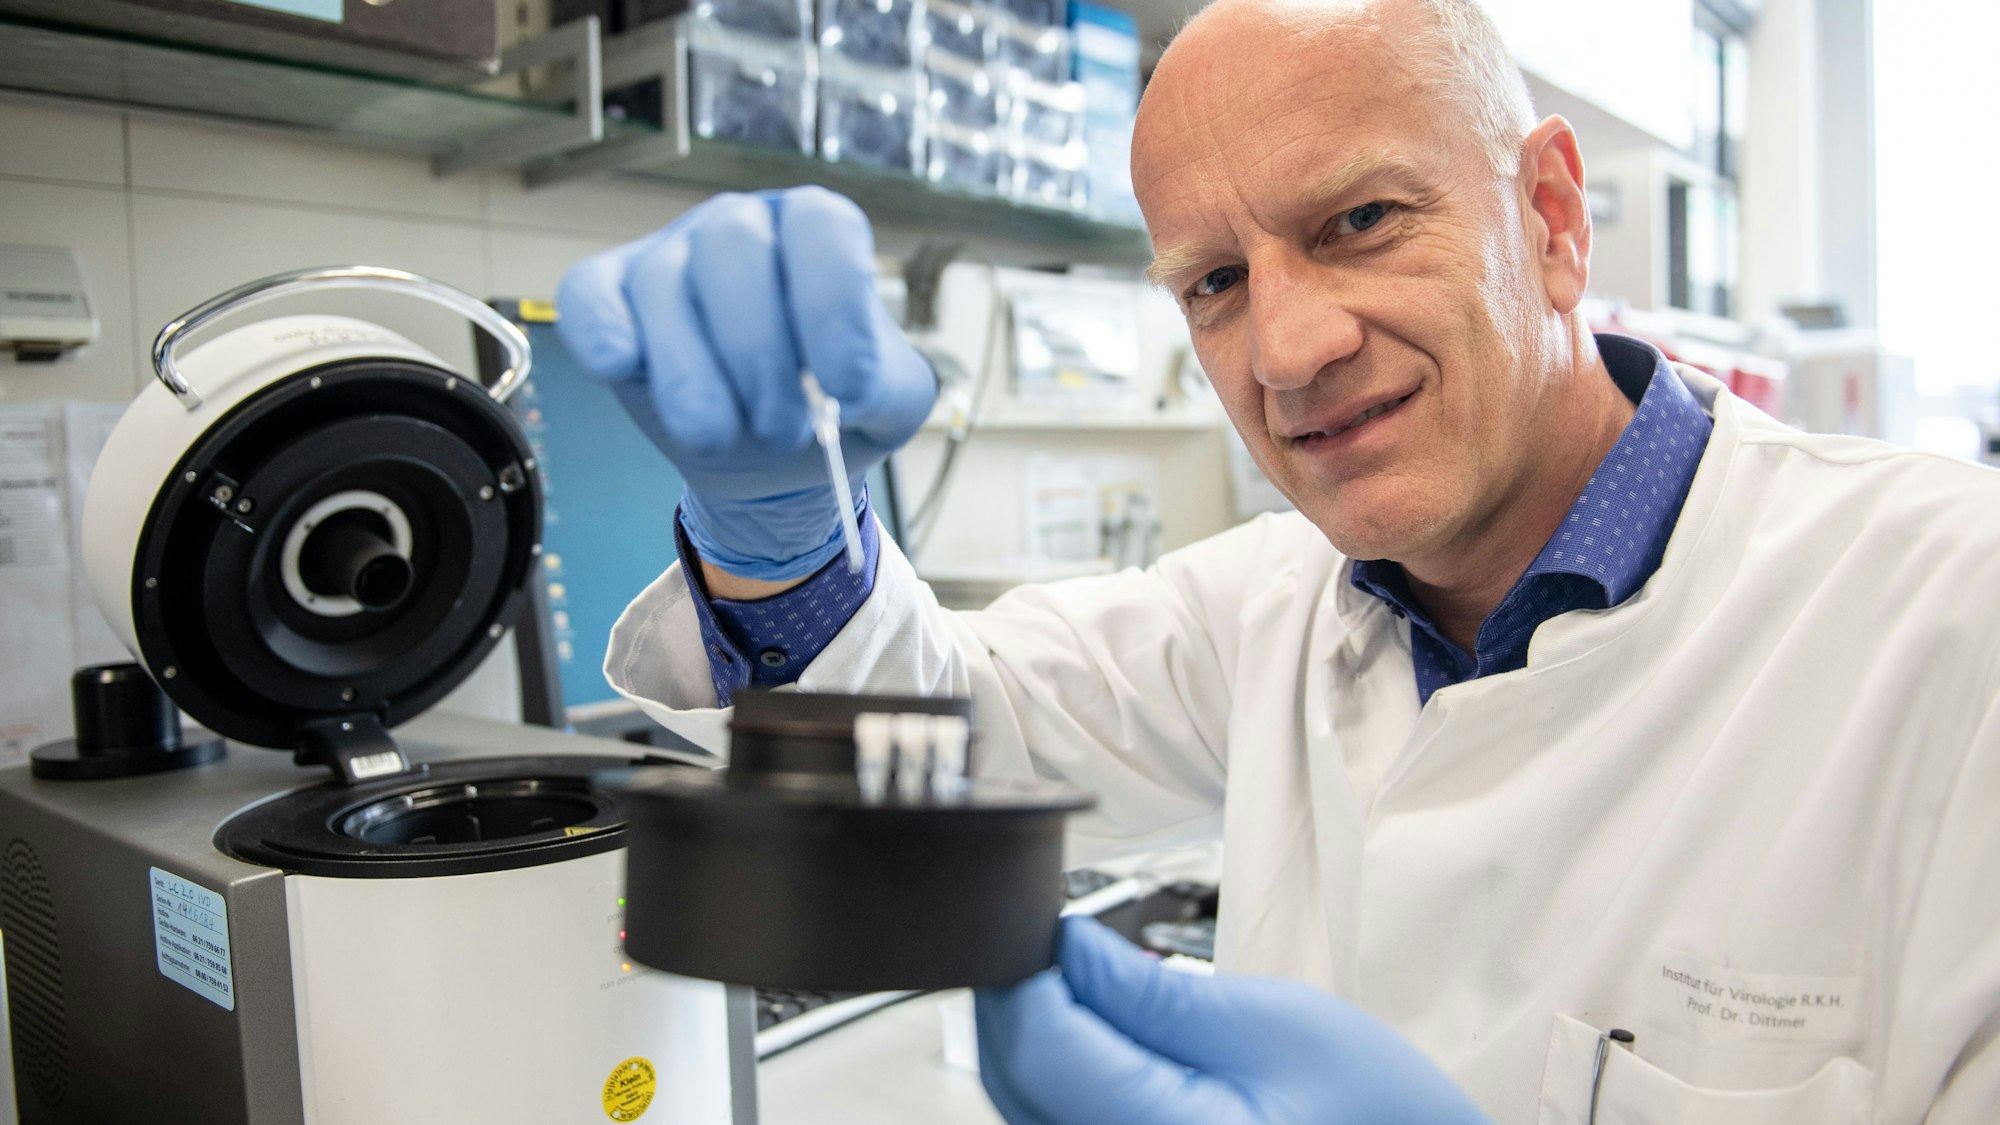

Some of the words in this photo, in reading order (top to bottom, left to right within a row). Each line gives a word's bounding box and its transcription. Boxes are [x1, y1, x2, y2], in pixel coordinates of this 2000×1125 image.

[1661, 965, 1701, 990] Institut
[1704, 979, 1724, 997] für
[1729, 987, 1797, 1009] Virologie
[1801, 994, 1846, 1008] R.K.H.
[1687, 997, 1715, 1017] Prof.
[1720, 1008, 1743, 1024] Dr.
[1749, 1012, 1806, 1028] Dittmer
